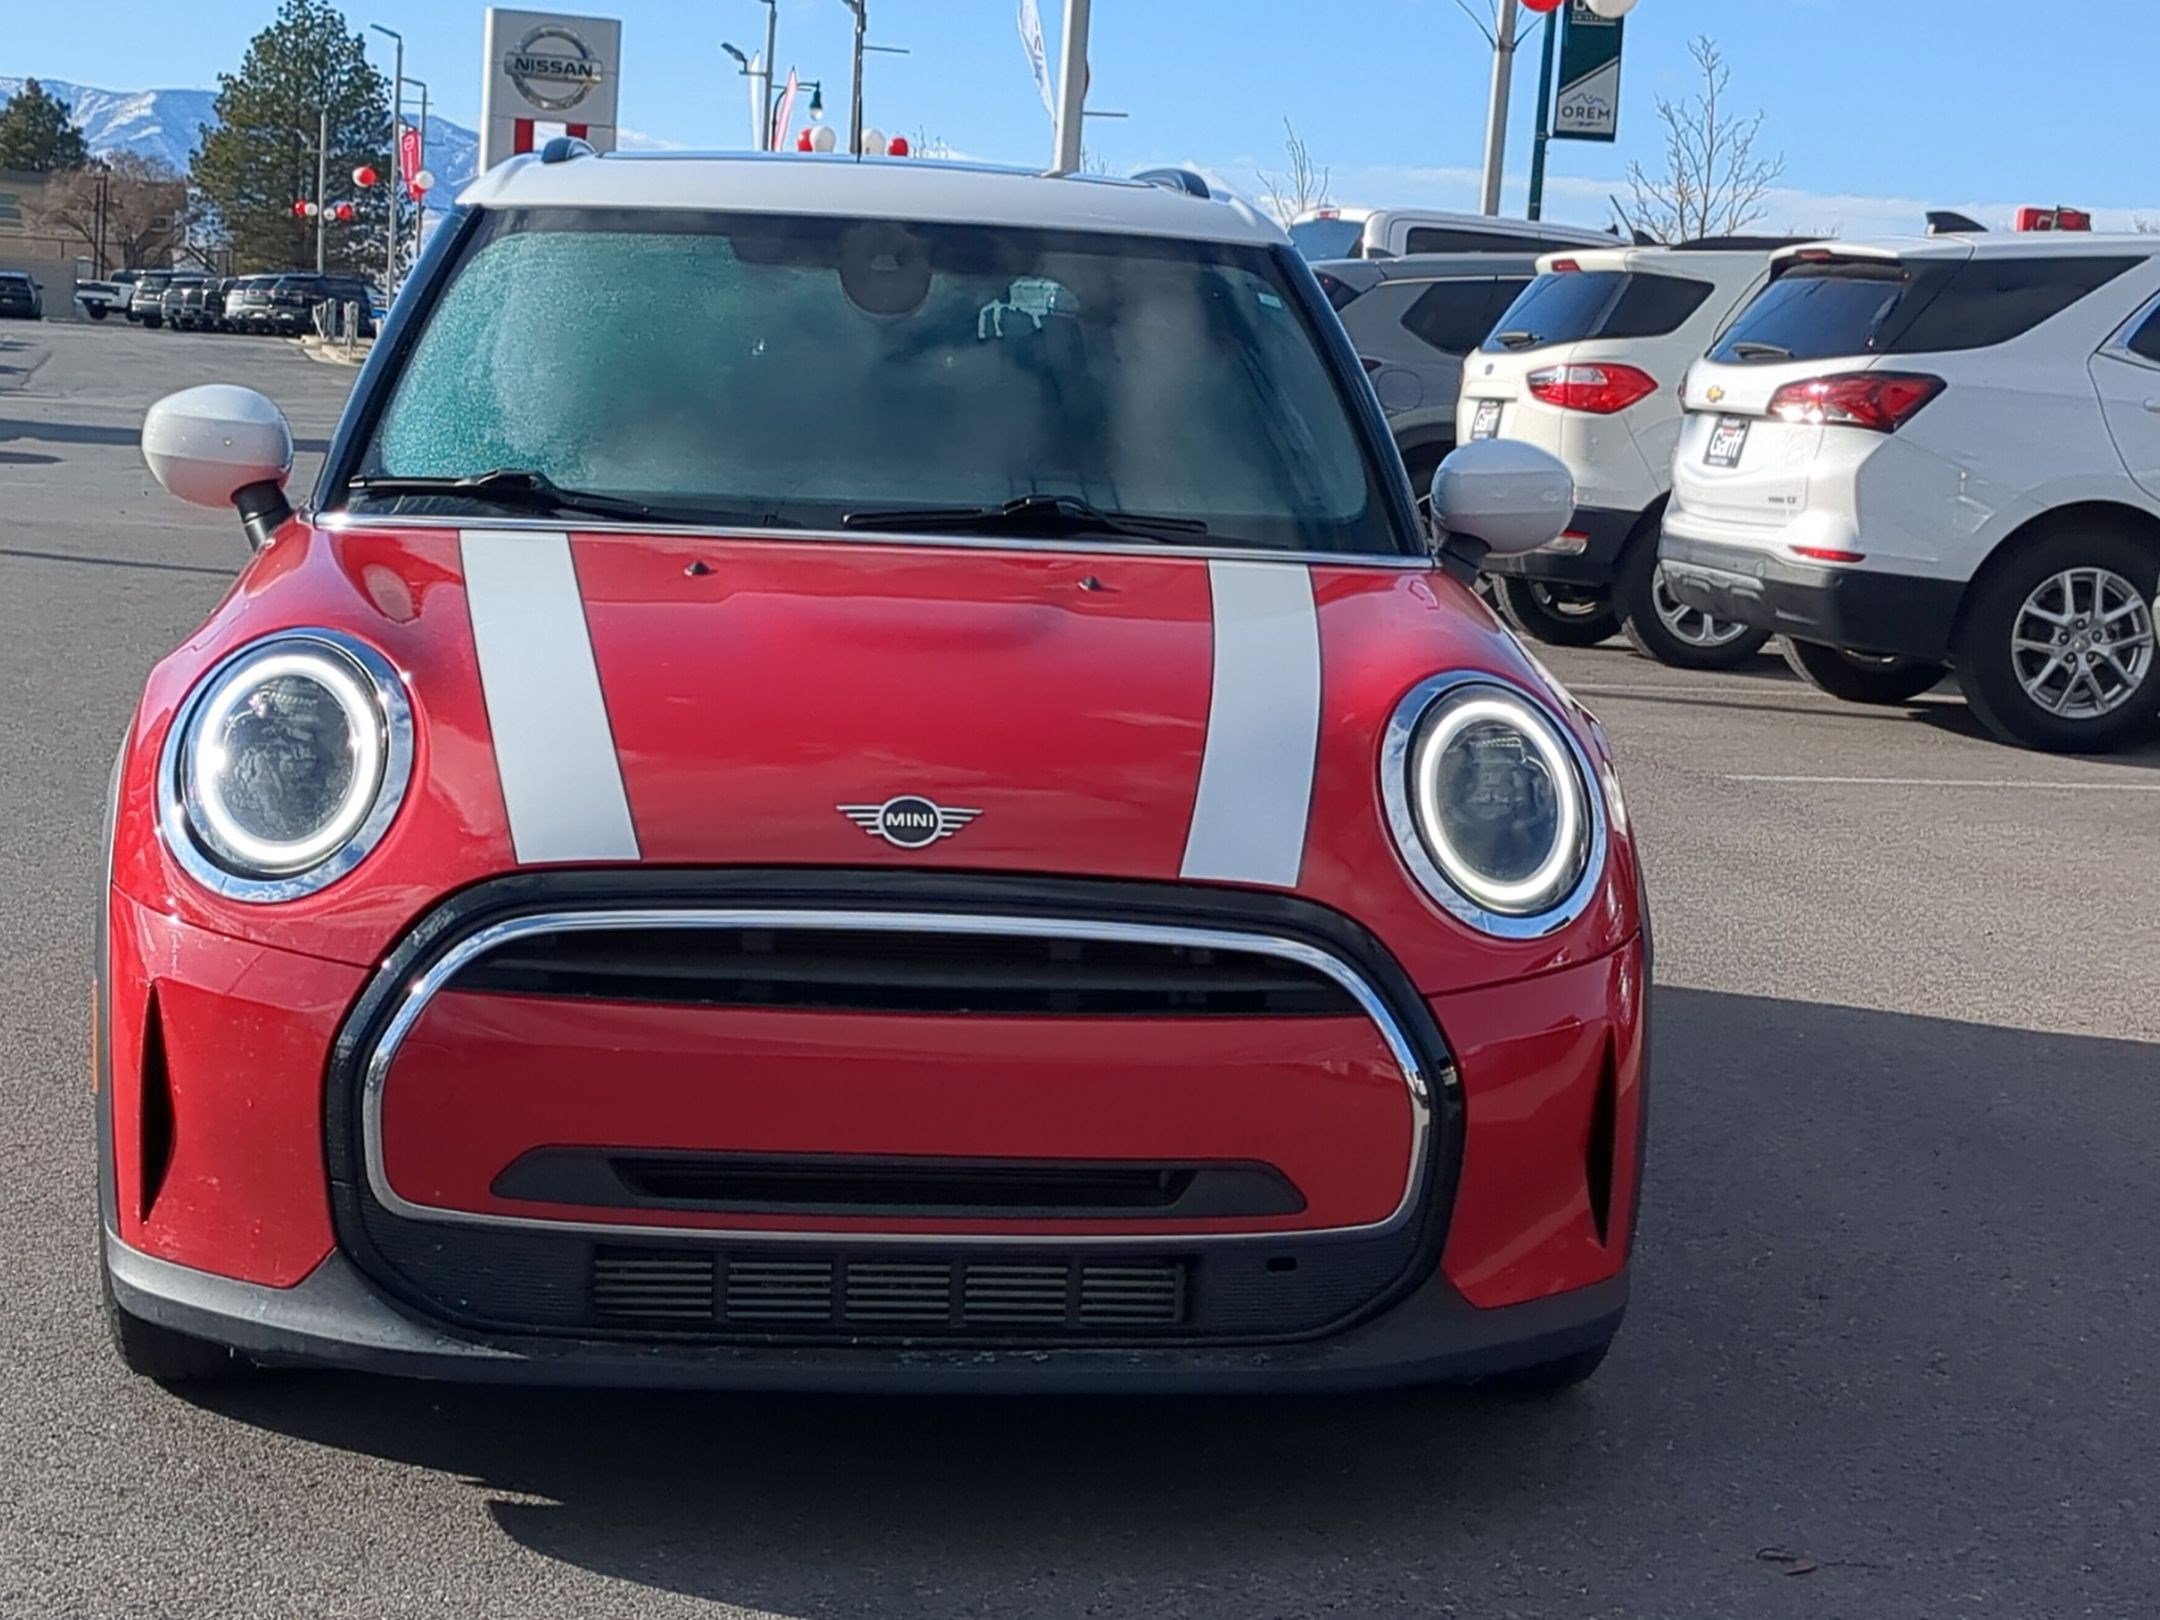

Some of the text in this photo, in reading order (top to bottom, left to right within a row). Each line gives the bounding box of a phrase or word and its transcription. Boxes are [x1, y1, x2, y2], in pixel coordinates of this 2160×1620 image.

[514, 57, 593, 77] NISSAN
[1561, 105, 1611, 121] OREM
[885, 812, 934, 828] MINI
